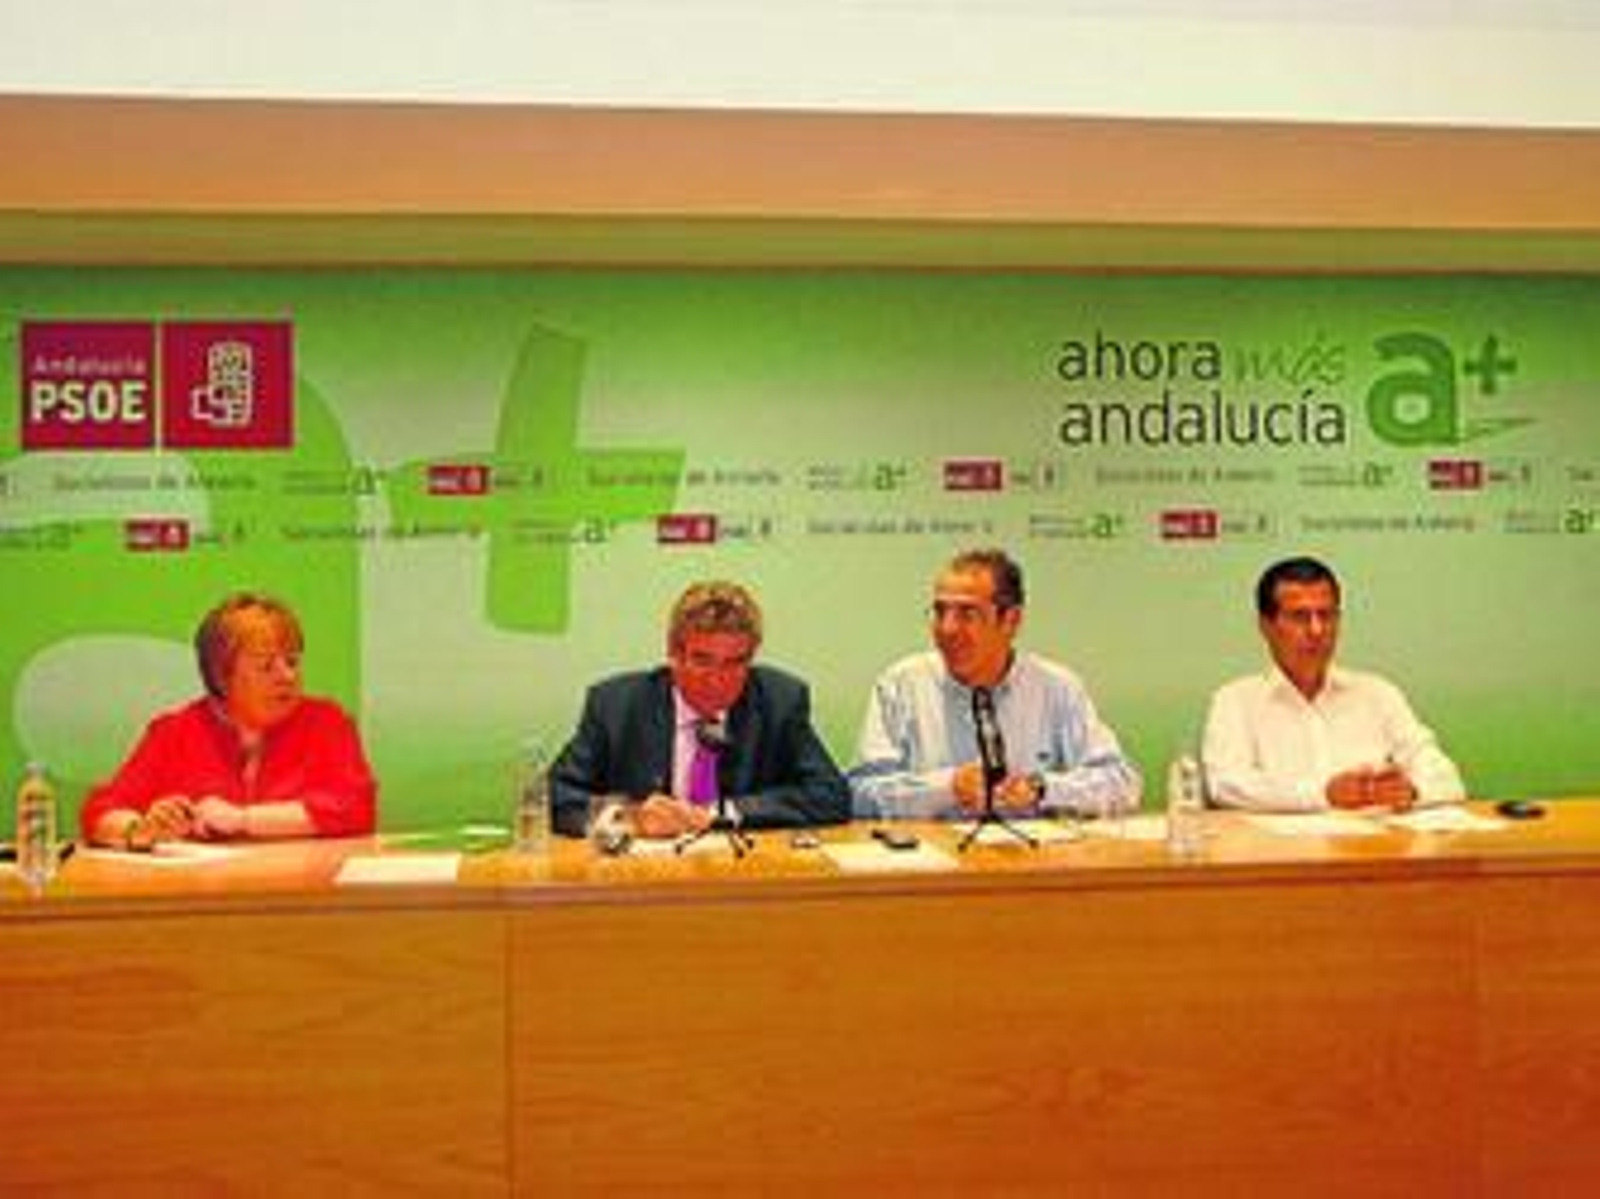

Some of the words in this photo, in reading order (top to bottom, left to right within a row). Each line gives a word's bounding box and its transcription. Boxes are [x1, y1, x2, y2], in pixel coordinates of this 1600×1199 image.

[1057, 331, 1221, 379] ahora
[1233, 331, 1346, 384] más
[31, 380, 146, 421] PSOE
[1060, 390, 1346, 445] andalucía
